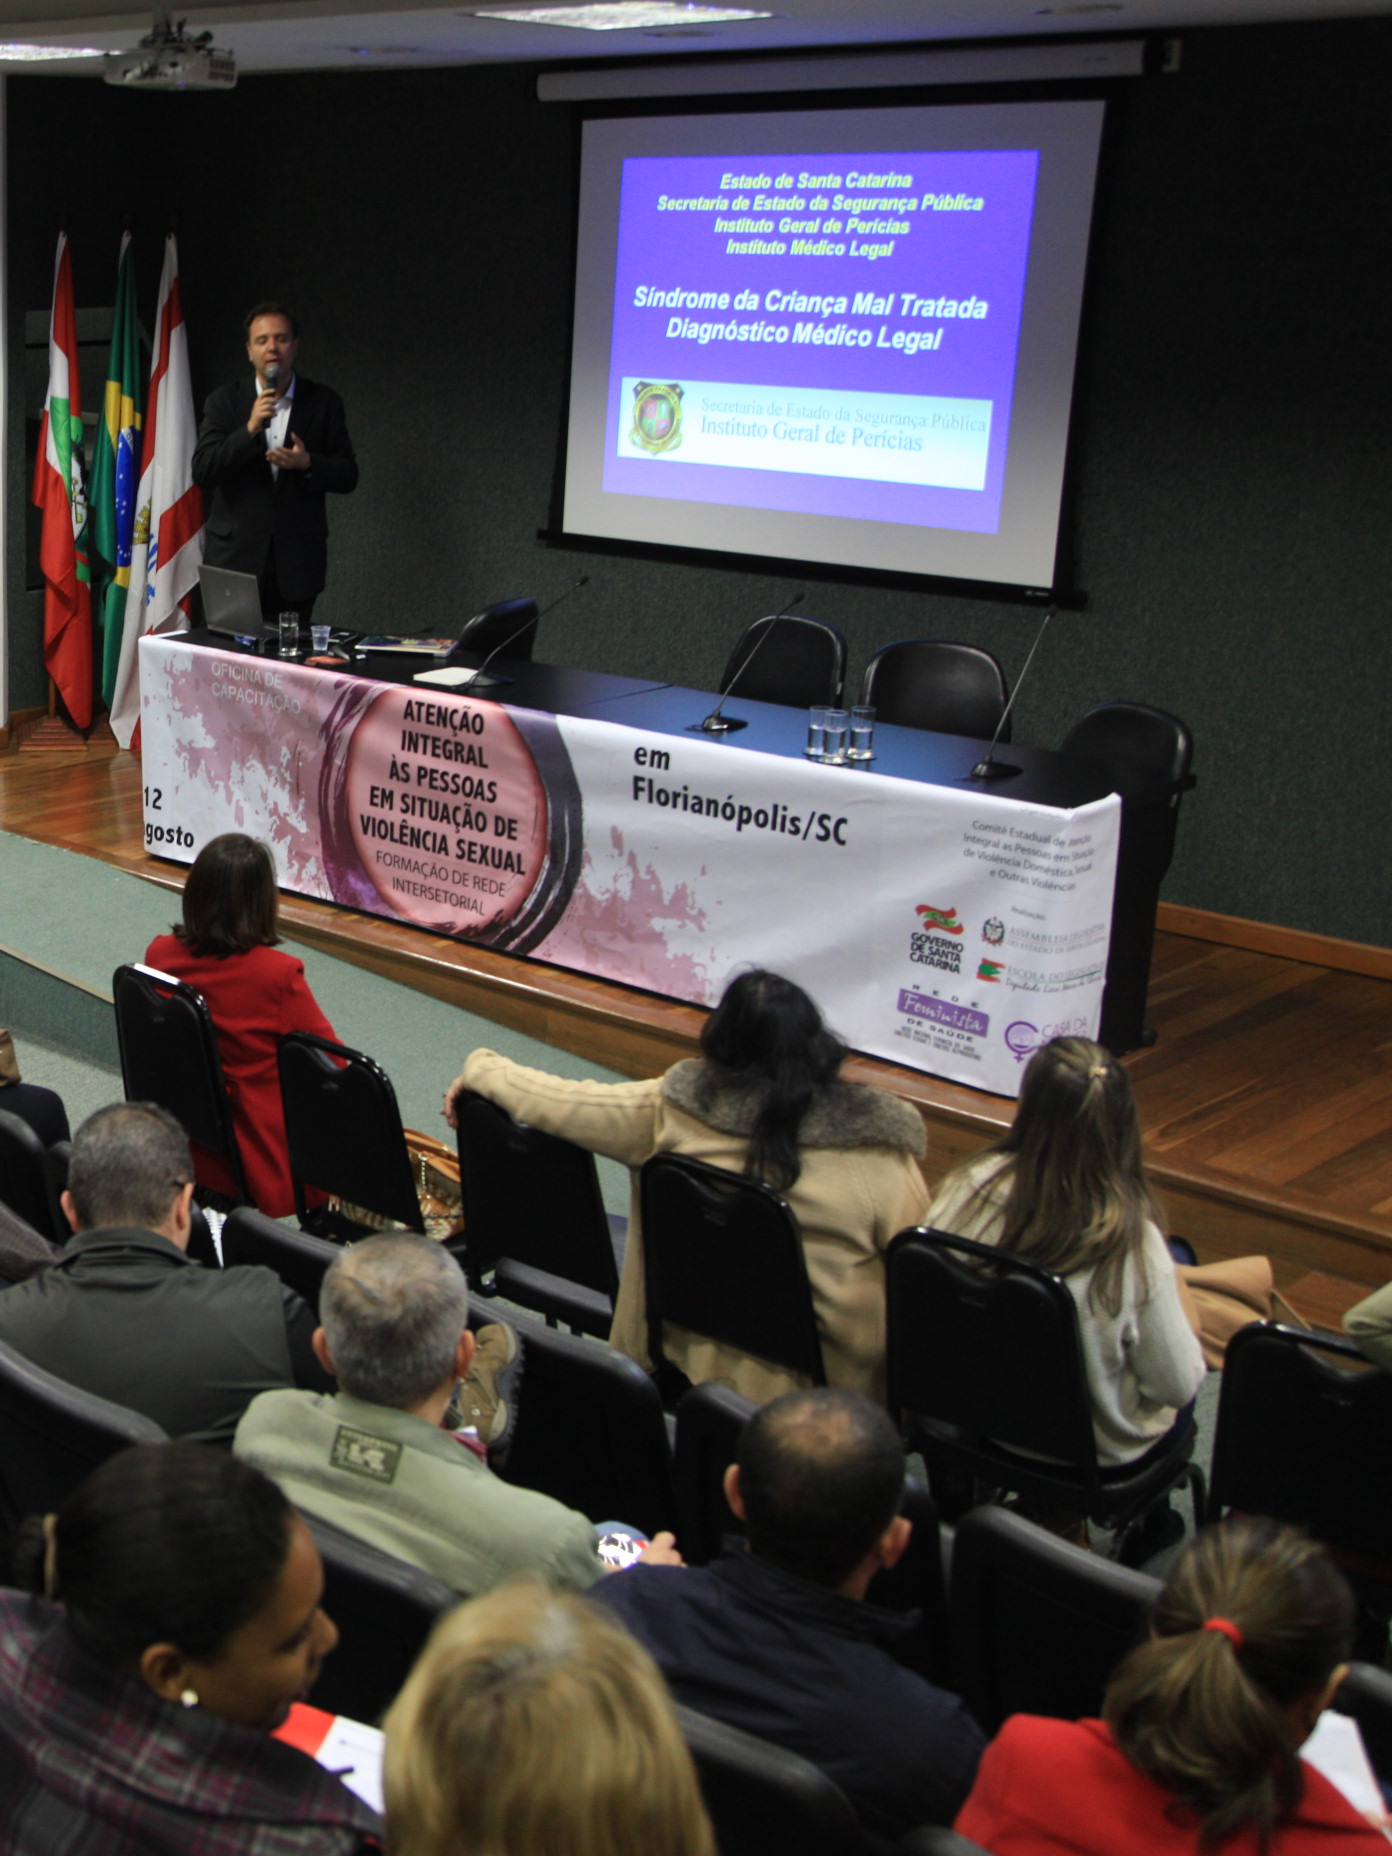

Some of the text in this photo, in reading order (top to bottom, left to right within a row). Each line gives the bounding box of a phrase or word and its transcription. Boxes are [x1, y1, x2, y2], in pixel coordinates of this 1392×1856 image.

[719, 172, 912, 189] Estado de Santa Catarina
[657, 194, 984, 214] Secretaria de Estado da Segurança Pública
[714, 217, 774, 233] Instituto
[778, 217, 821, 234] Geral
[823, 218, 842, 234] de
[726, 239, 895, 259] Instituto Médico Legal
[634, 285, 988, 319] Síndrome da Criança Mal Tratada
[666, 316, 943, 355] Diagnóstico Médico Legal
[701, 397, 986, 432] Secretaria de Estado da Segurança Pública
[701, 416, 923, 452] Instituto Geral de Perícias
[211, 661, 283, 689] OFICINA DE
[211, 682, 301, 714] CAPACITAÇÃO
[403, 700, 484, 737] ATENÇÃO
[401, 730, 488, 769] INTEGRAL
[634, 746, 670, 770] em
[389, 754, 497, 803] ÀS PESSOAS
[144, 786, 162, 811] 12
[369, 785, 518, 841] EM SITUAÇÃO DE
[633, 775, 848, 846] Florianópolis/SC
[360, 814, 526, 875] VIOLÊNCIA SEXUAL
[963, 833, 1000, 849] Integral
[1014, 843, 1052, 860] Pessoas
[1053, 853, 1070, 863] em
[1009, 827, 1051, 844] Estadual
[1052, 836, 1065, 847] de
[963, 847, 975, 858] de
[376, 851, 506, 897] FORMAÇÃO DE REDE
[989, 869, 996, 878] e
[998, 869, 1029, 885] Outras
[392, 877, 486, 916] INTERSETORIAL
[911, 931, 964, 953] GOVERNO
[911, 941, 961, 964] DE SANTA
[909, 952, 960, 974] CATARINA
[903, 992, 984, 1032] Feminista
[907, 1017, 974, 1043] DE SAÚDE
